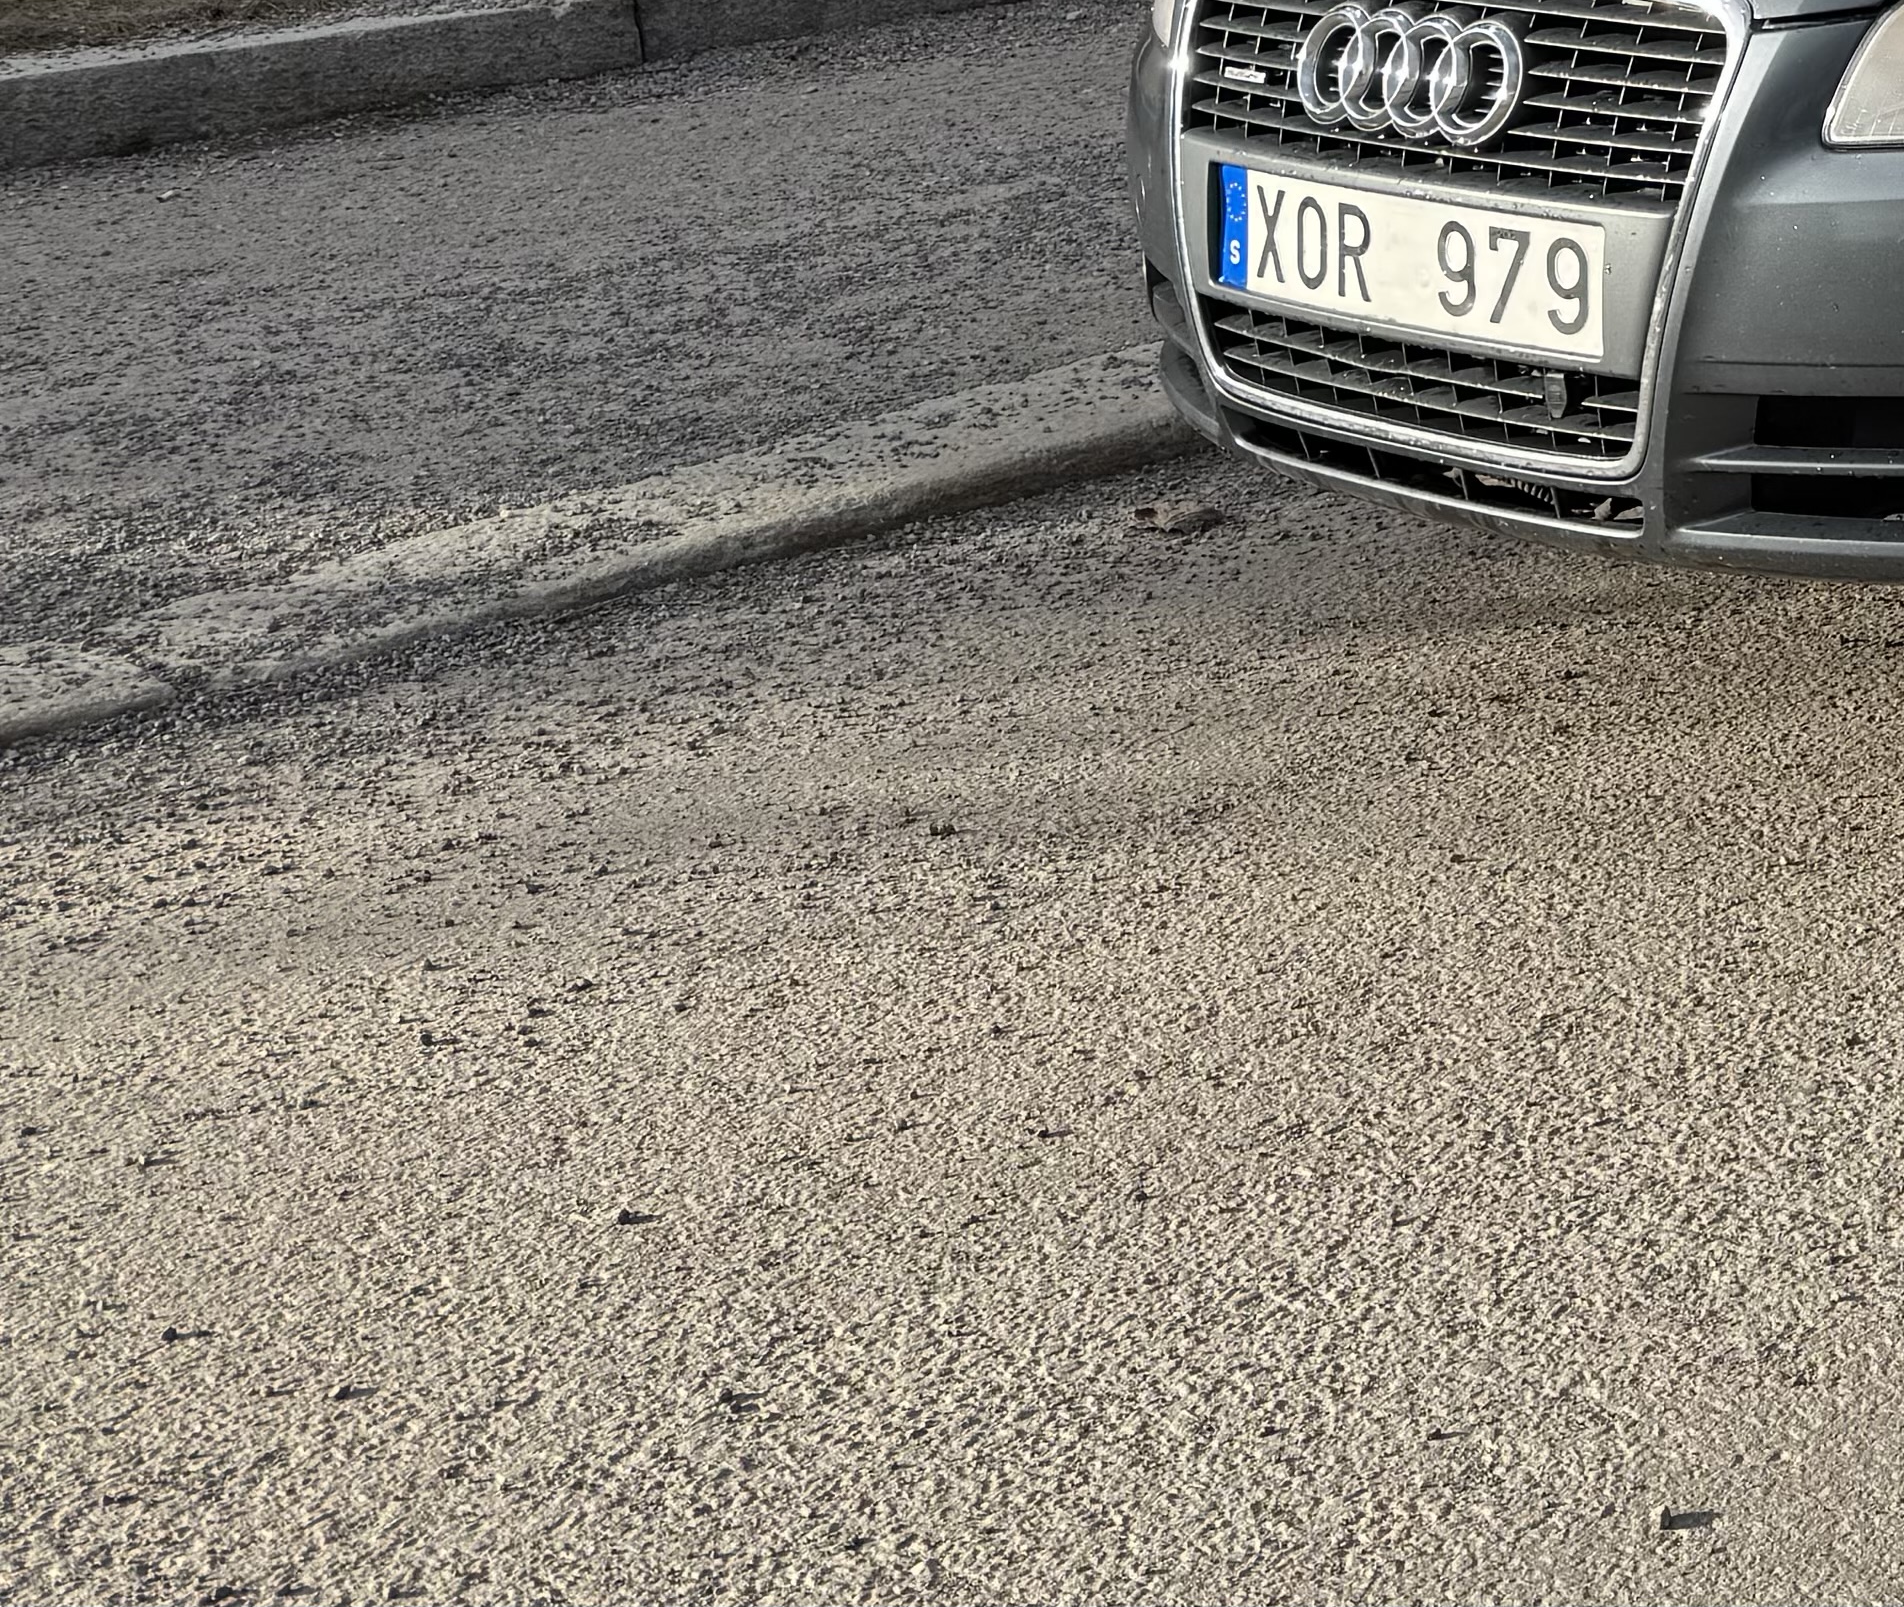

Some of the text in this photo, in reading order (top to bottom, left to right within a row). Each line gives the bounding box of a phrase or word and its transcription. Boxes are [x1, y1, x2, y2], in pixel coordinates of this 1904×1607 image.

[1229, 240, 1241, 265] S
[1256, 184, 1590, 335] XOR 979
